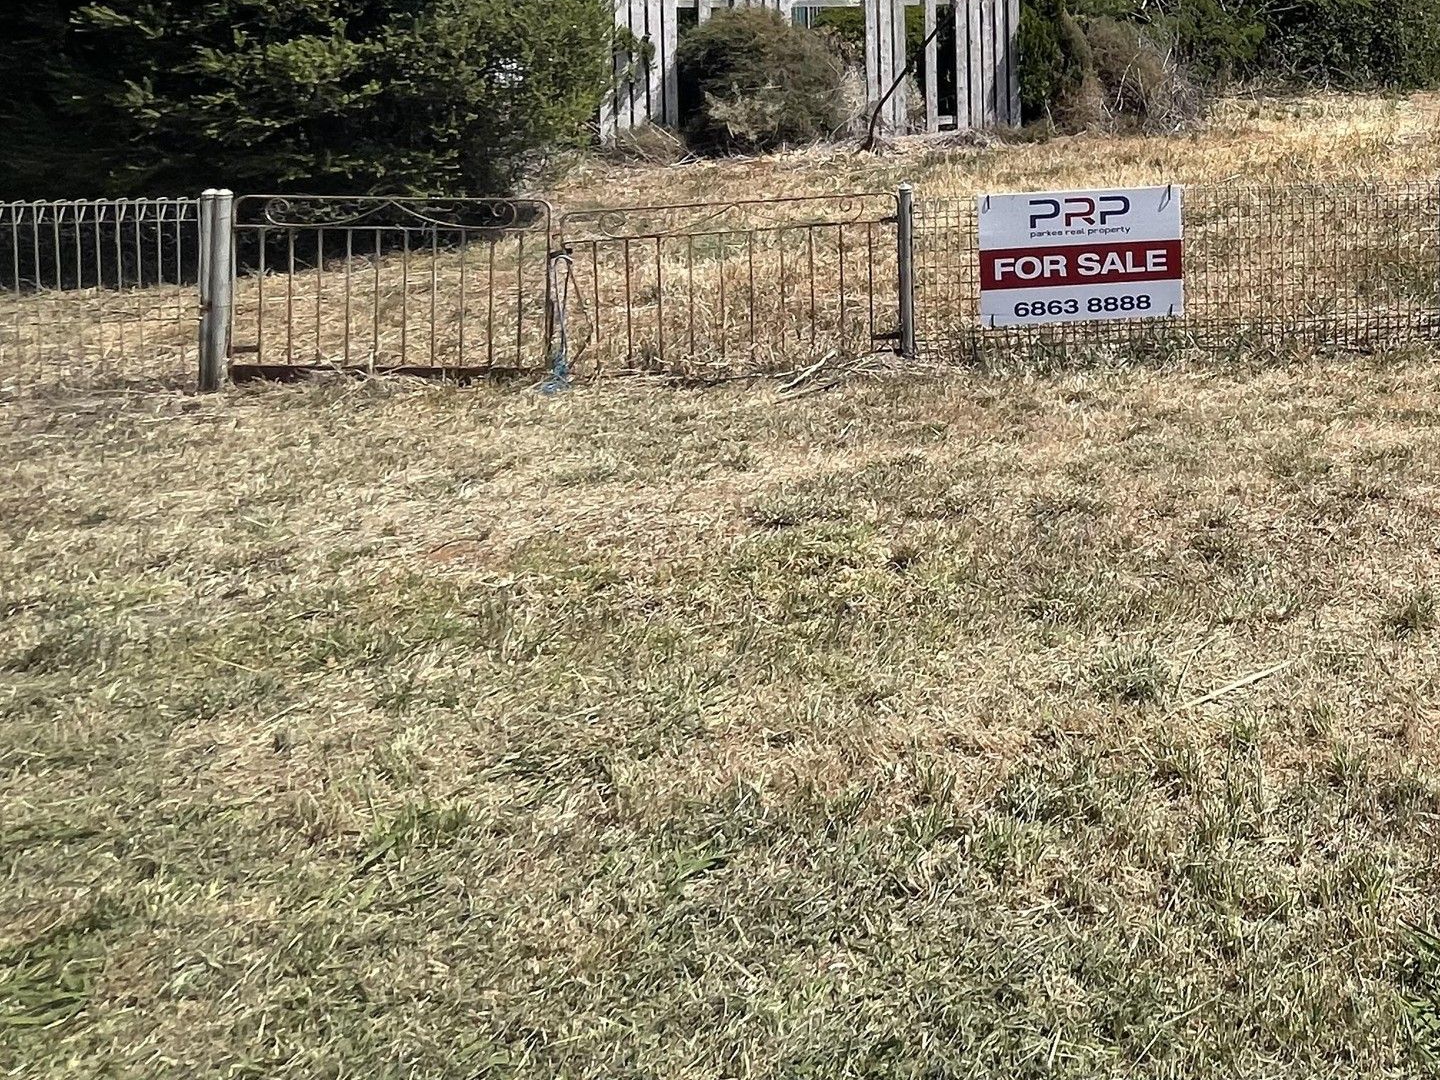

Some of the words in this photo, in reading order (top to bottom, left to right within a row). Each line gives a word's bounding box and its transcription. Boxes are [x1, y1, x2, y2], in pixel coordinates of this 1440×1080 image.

[1029, 195, 1130, 229] PRP
[1030, 230, 1063, 238] parkes
[1065, 228, 1085, 236] real
[1087, 226, 1131, 236] property
[994, 255, 1067, 281] FOR
[1077, 249, 1168, 276] SALE
[1014, 299, 1079, 318] 6863
[1087, 294, 1151, 313] 8888
